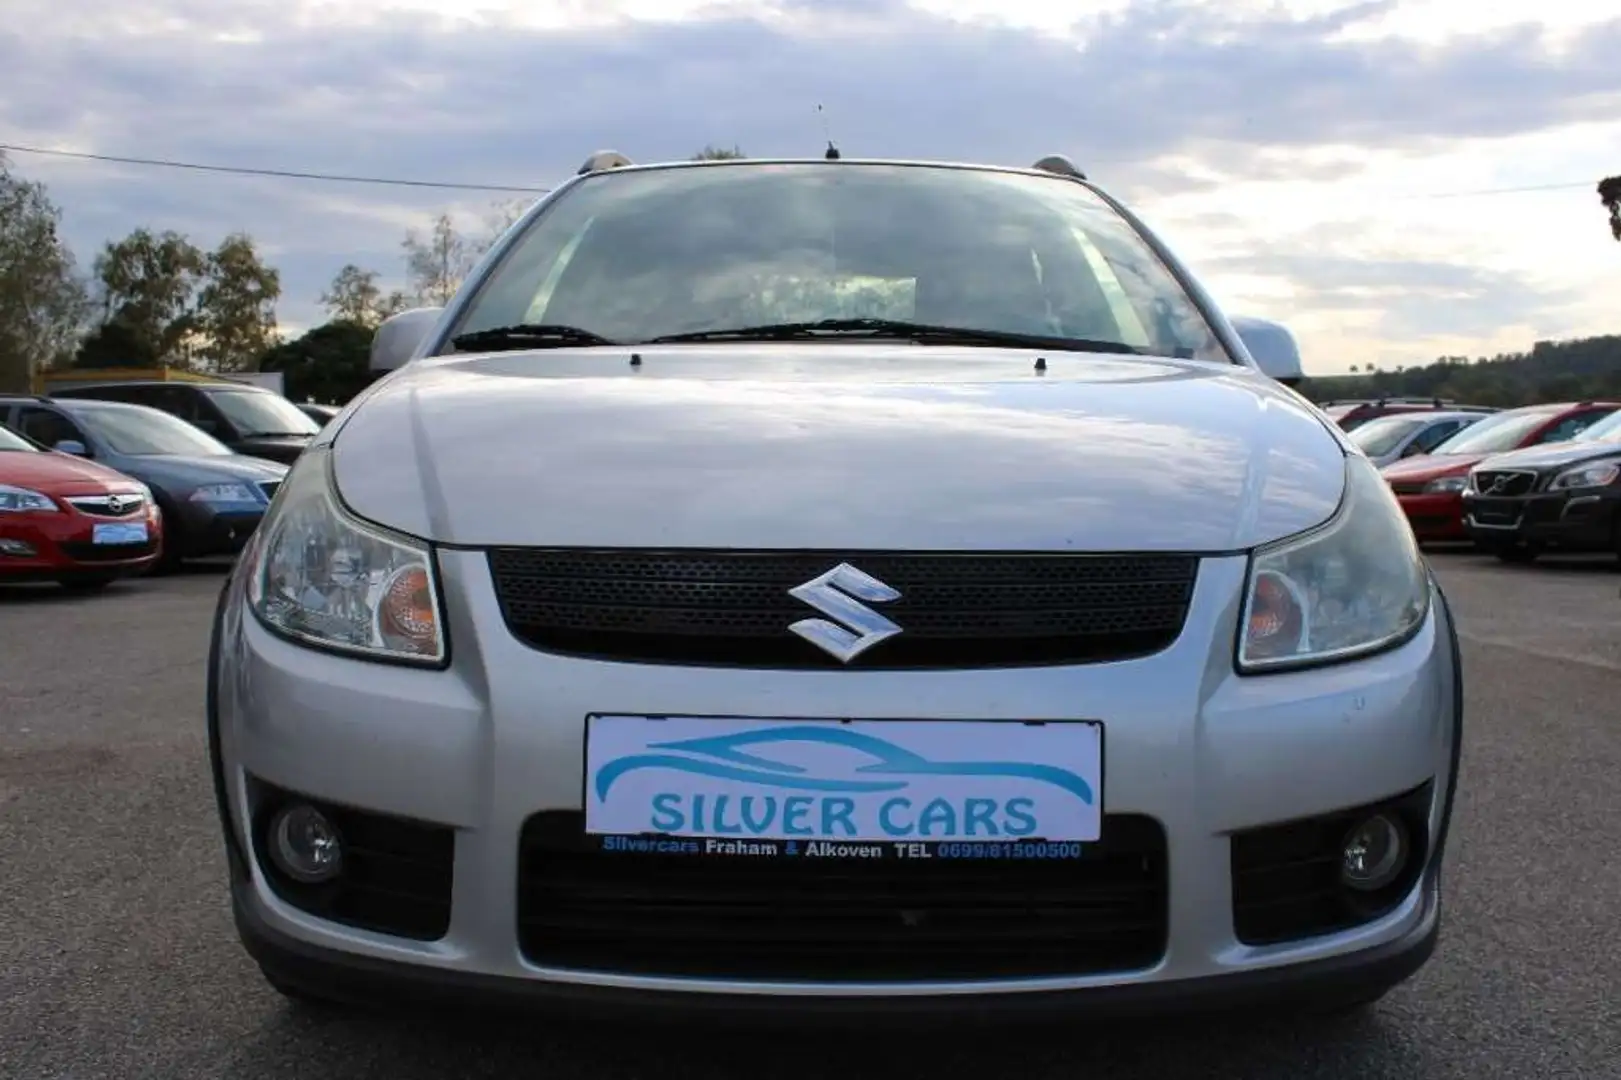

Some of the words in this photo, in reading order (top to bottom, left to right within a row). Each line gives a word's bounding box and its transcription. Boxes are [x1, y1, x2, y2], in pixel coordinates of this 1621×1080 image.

[651, 792, 857, 836] SILVER
[878, 796, 1037, 836] CARS
[603, 836, 700, 854] Silvercars
[706, 839, 778, 856] Fraham
[805, 841, 883, 858] Alkoven
[893, 843, 933, 859] TEL
